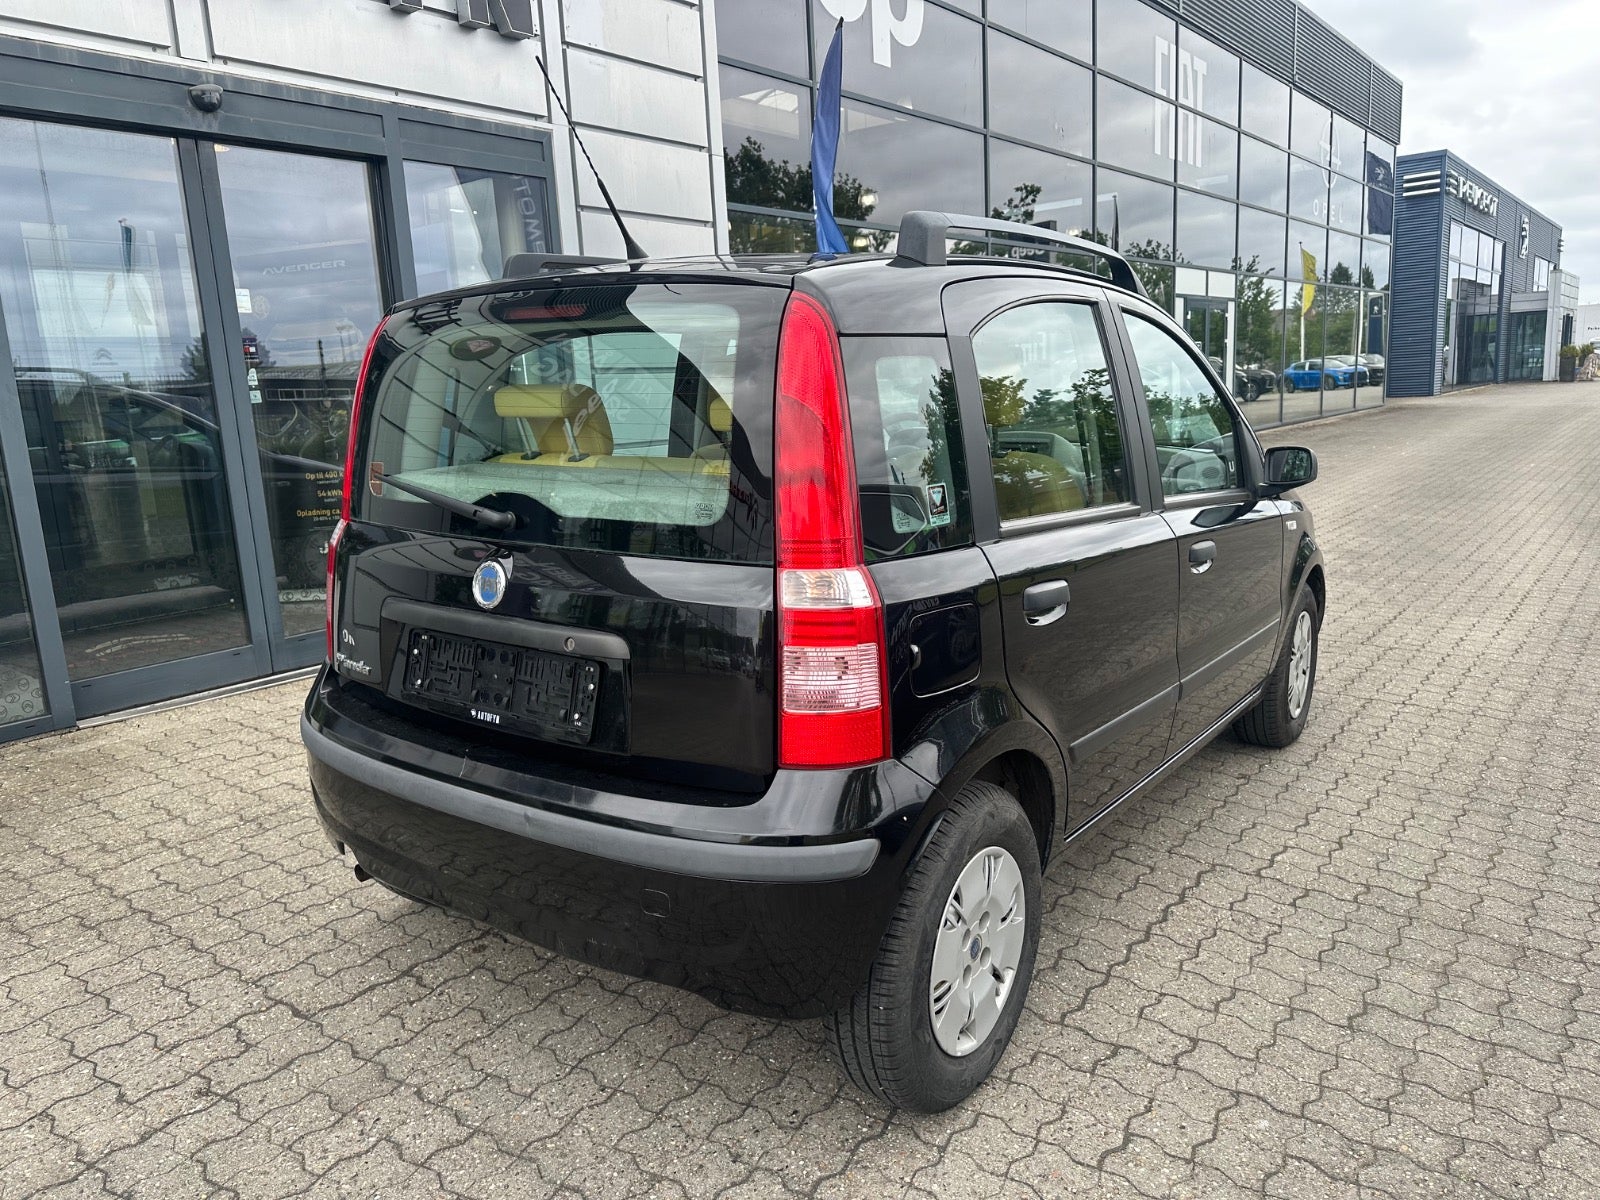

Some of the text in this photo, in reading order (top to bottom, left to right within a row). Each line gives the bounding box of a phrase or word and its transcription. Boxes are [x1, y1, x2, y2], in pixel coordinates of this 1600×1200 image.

[1154, 35, 1207, 168] FIAT
[1457, 175, 1499, 217] PEUGEOT
[1312, 198, 1343, 224] OPEL
[262, 259, 346, 276] AVENGER
[296, 509, 331, 517] Opladning
